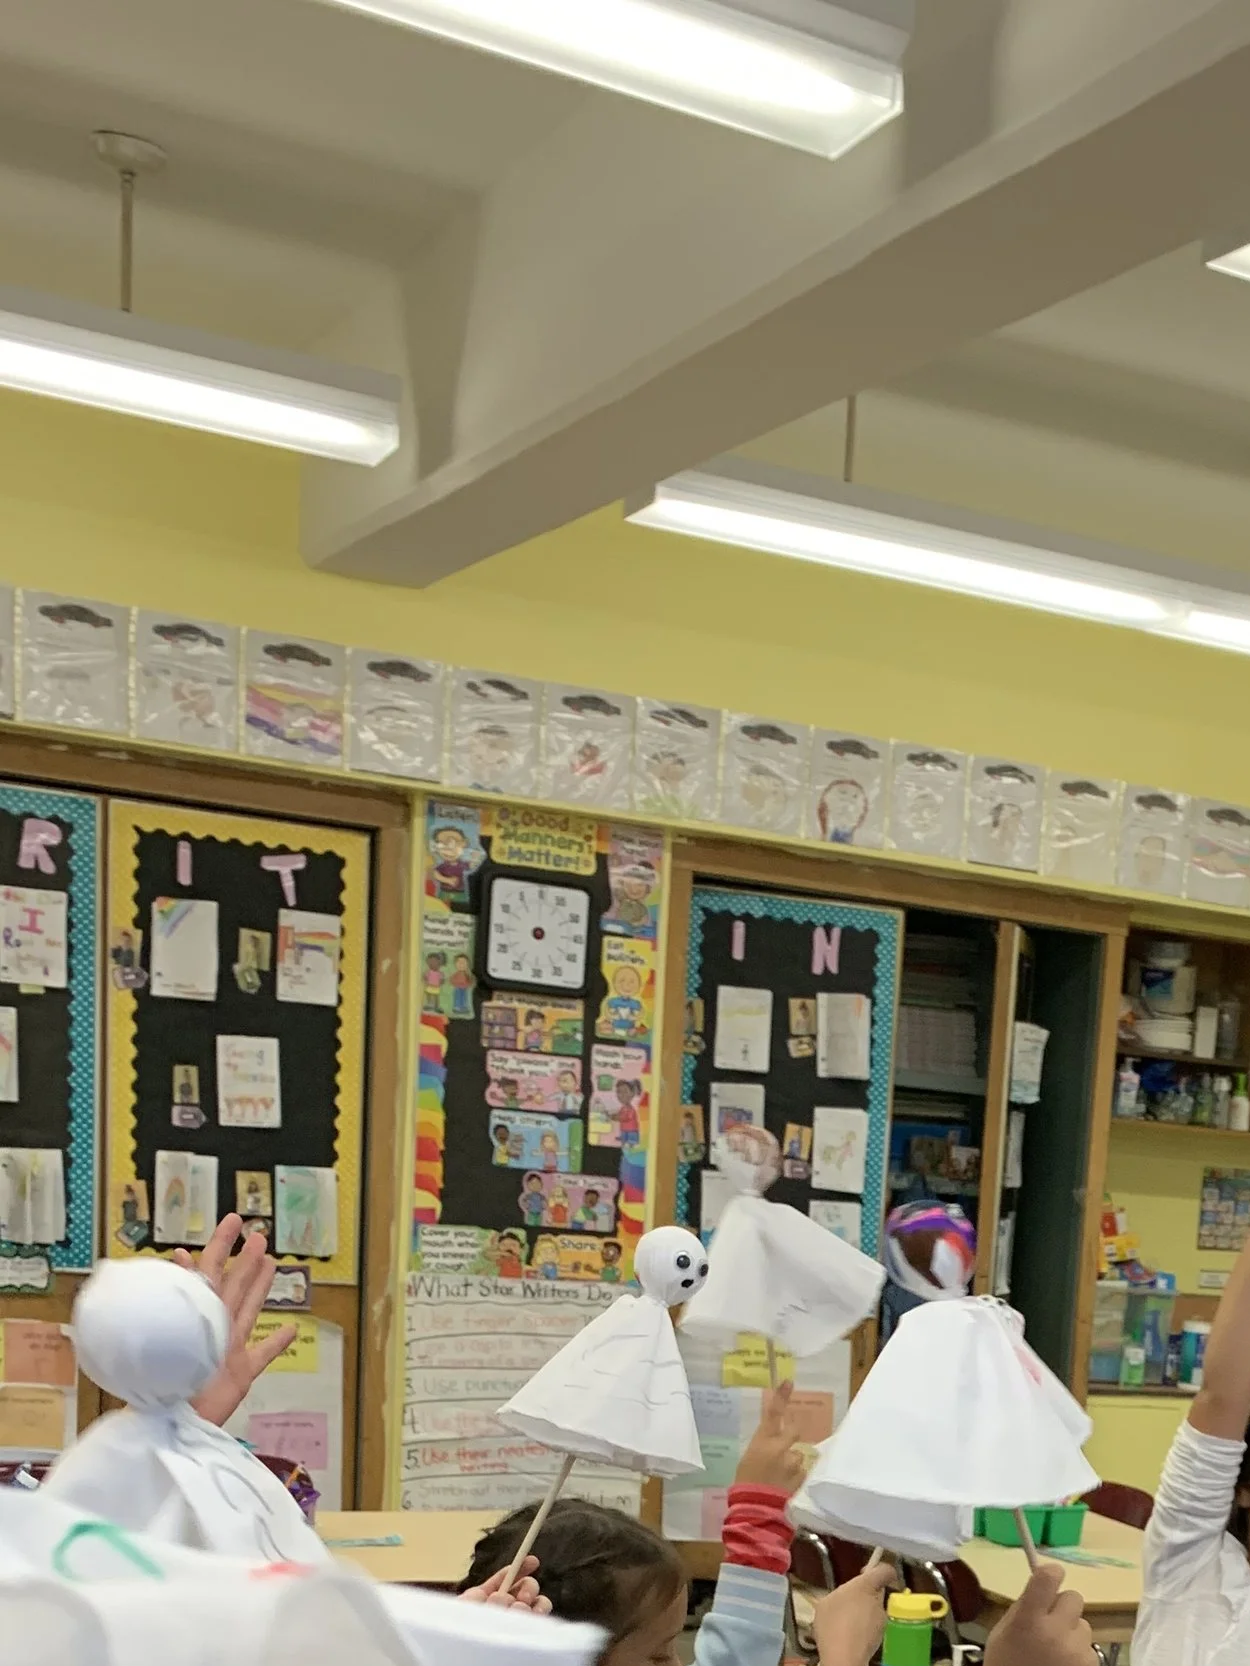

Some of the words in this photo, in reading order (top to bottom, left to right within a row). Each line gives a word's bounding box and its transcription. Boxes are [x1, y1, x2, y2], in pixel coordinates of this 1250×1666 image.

[521, 811, 570, 831] Good
[17, 818, 63, 875] R
[501, 826, 585, 853] Manners
[508, 846, 580, 868] Matter!
[260, 854, 306, 906] T
[811, 926, 841, 975] N
[491, 1053, 508, 1066] Say
[421, 1226, 450, 1238] Cover
[453, 1230, 476, 1240] your
[422, 1238, 454, 1249] mouth
[422, 1251, 439, 1260] you
[442, 1251, 477, 1260] sneeze
[413, 1275, 473, 1299] What
[479, 1278, 514, 1297] Star
[522, 1280, 579, 1299] Writers
[585, 1284, 613, 1301] Do
[404, 1377, 416, 1397] 3
[423, 1379, 459, 1396] Use
[404, 1449, 420, 1470] 5
[421, 1447, 450, 1466] Use
[402, 1489, 412, 1510] 6
